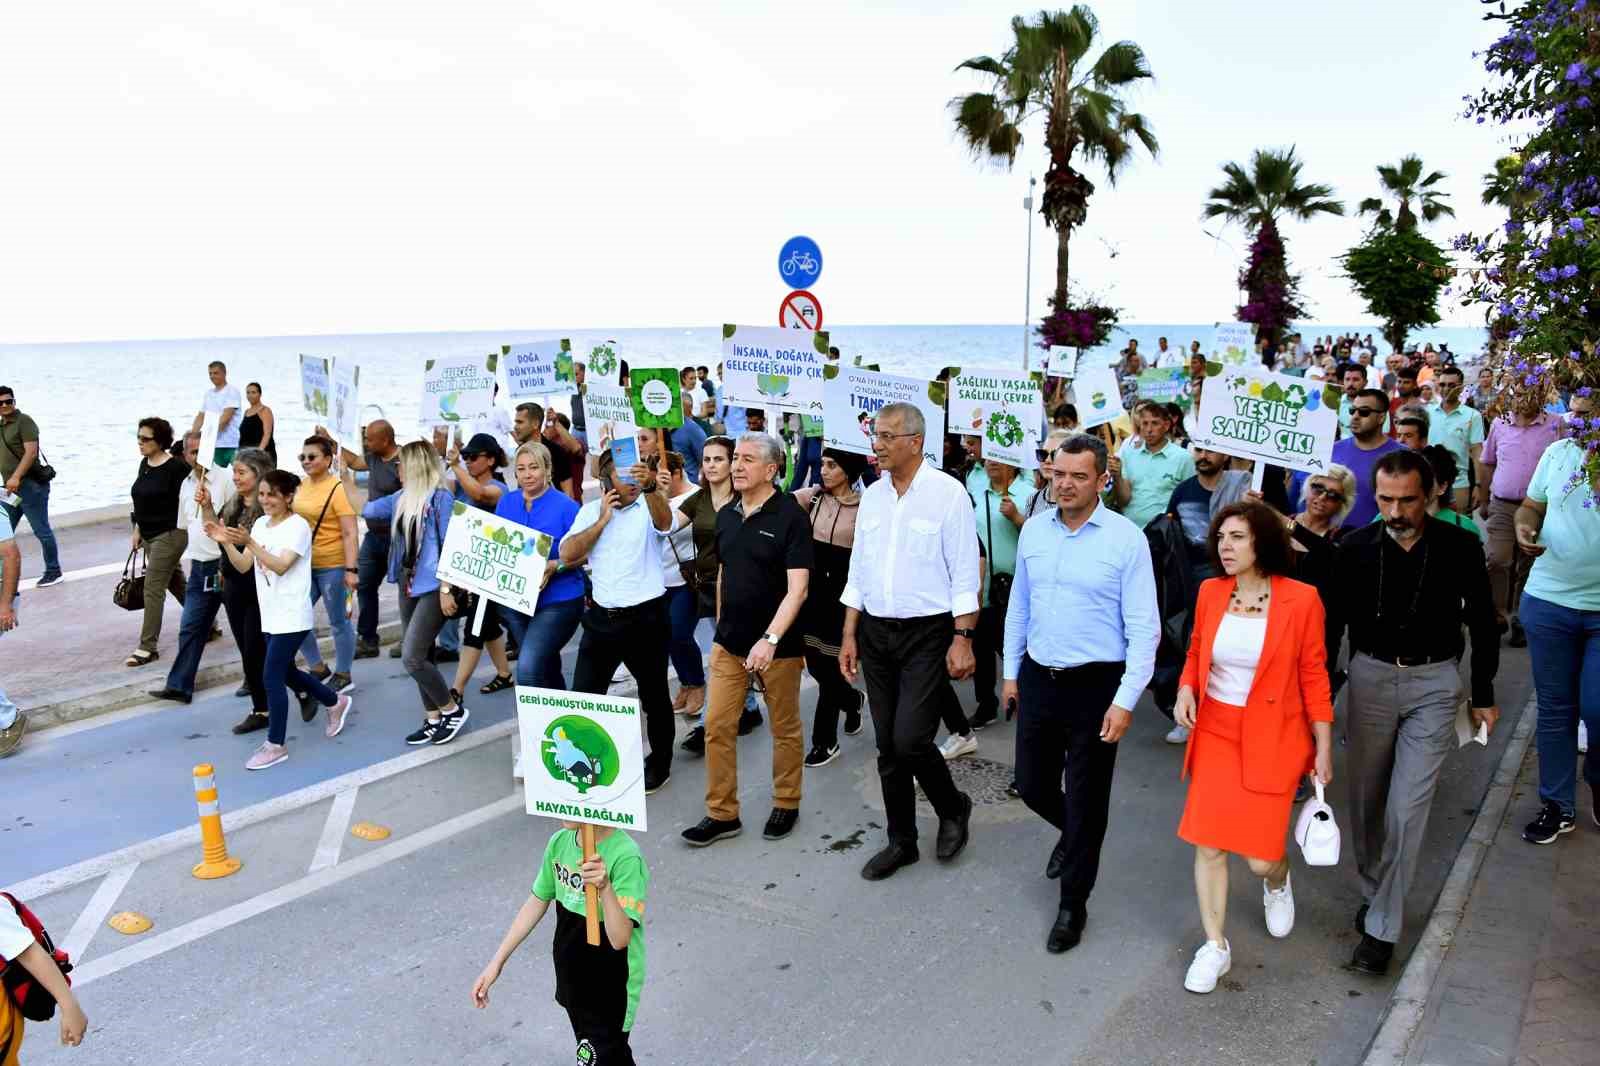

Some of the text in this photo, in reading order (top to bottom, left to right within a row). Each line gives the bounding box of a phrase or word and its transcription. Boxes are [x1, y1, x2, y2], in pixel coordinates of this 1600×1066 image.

[517, 352, 539, 364] DOĞA
[733, 344, 818, 364] İNSANA, DOĞAYA,
[509, 364, 551, 377] DÜNYANIN
[726, 360, 770, 374] GELECEĞE
[774, 363, 802, 376] SAHİP
[520, 377, 545, 389] EVİDİR
[956, 376, 1037, 391] SAĞLIKLI YAŞAM
[959, 389, 1033, 404] SAĞLIKLI ÇEVRE
[1234, 395, 1299, 427] YEŞİLE
[1212, 416, 1315, 454] SAHİP ÇIK!
[471, 535, 518, 568] YEŞİLE
[451, 552, 495, 581] SAHİP
[519, 694, 635, 715] GERİ DÖNÜŞTÜR KULLAN
[536, 801, 634, 825] HAYATA BAĞLAN
